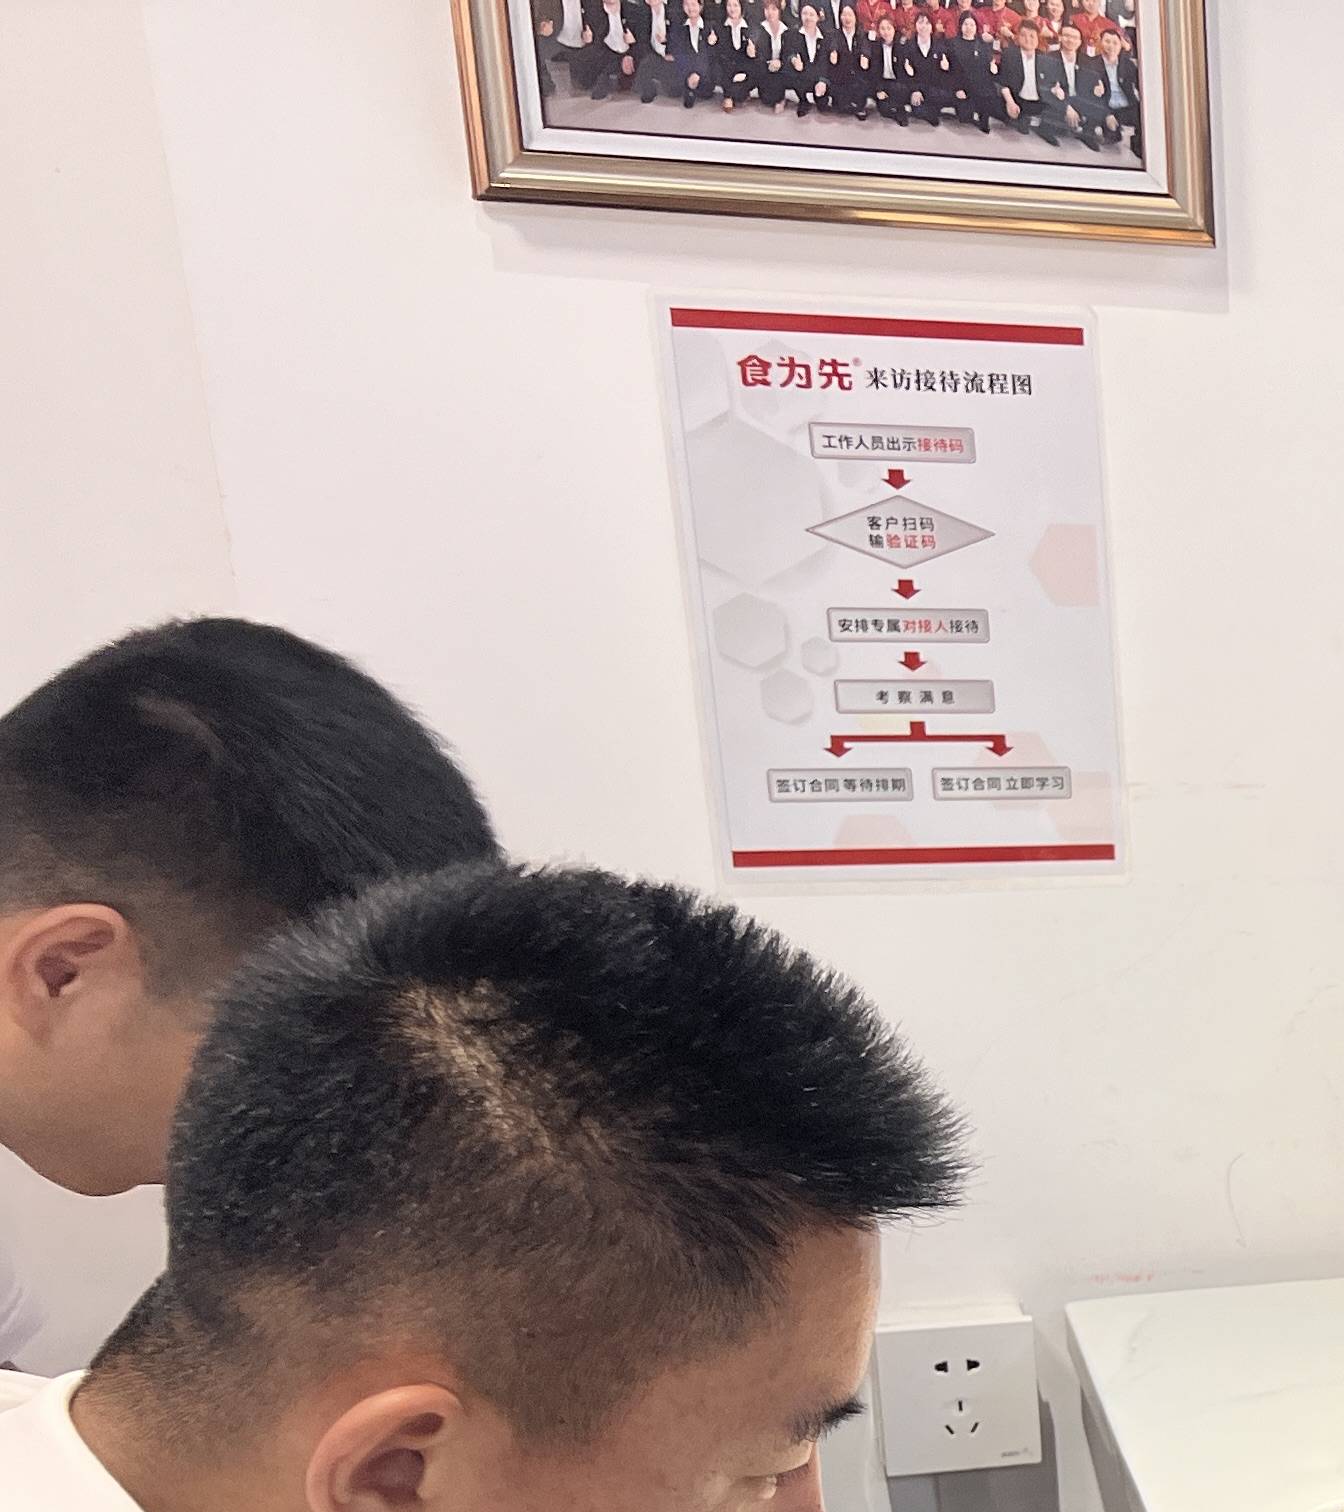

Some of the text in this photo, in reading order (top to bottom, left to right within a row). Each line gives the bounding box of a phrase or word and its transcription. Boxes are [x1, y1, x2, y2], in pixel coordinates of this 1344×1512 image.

[737, 354, 1034, 397] 食为先 来访接待流程图
[821, 433, 965, 455] 工作人员出示接待码
[866, 515, 936, 533] 客户扫码
[868, 532, 938, 550] 输验证码
[837, 617, 980, 636] 安排专属对接人接待
